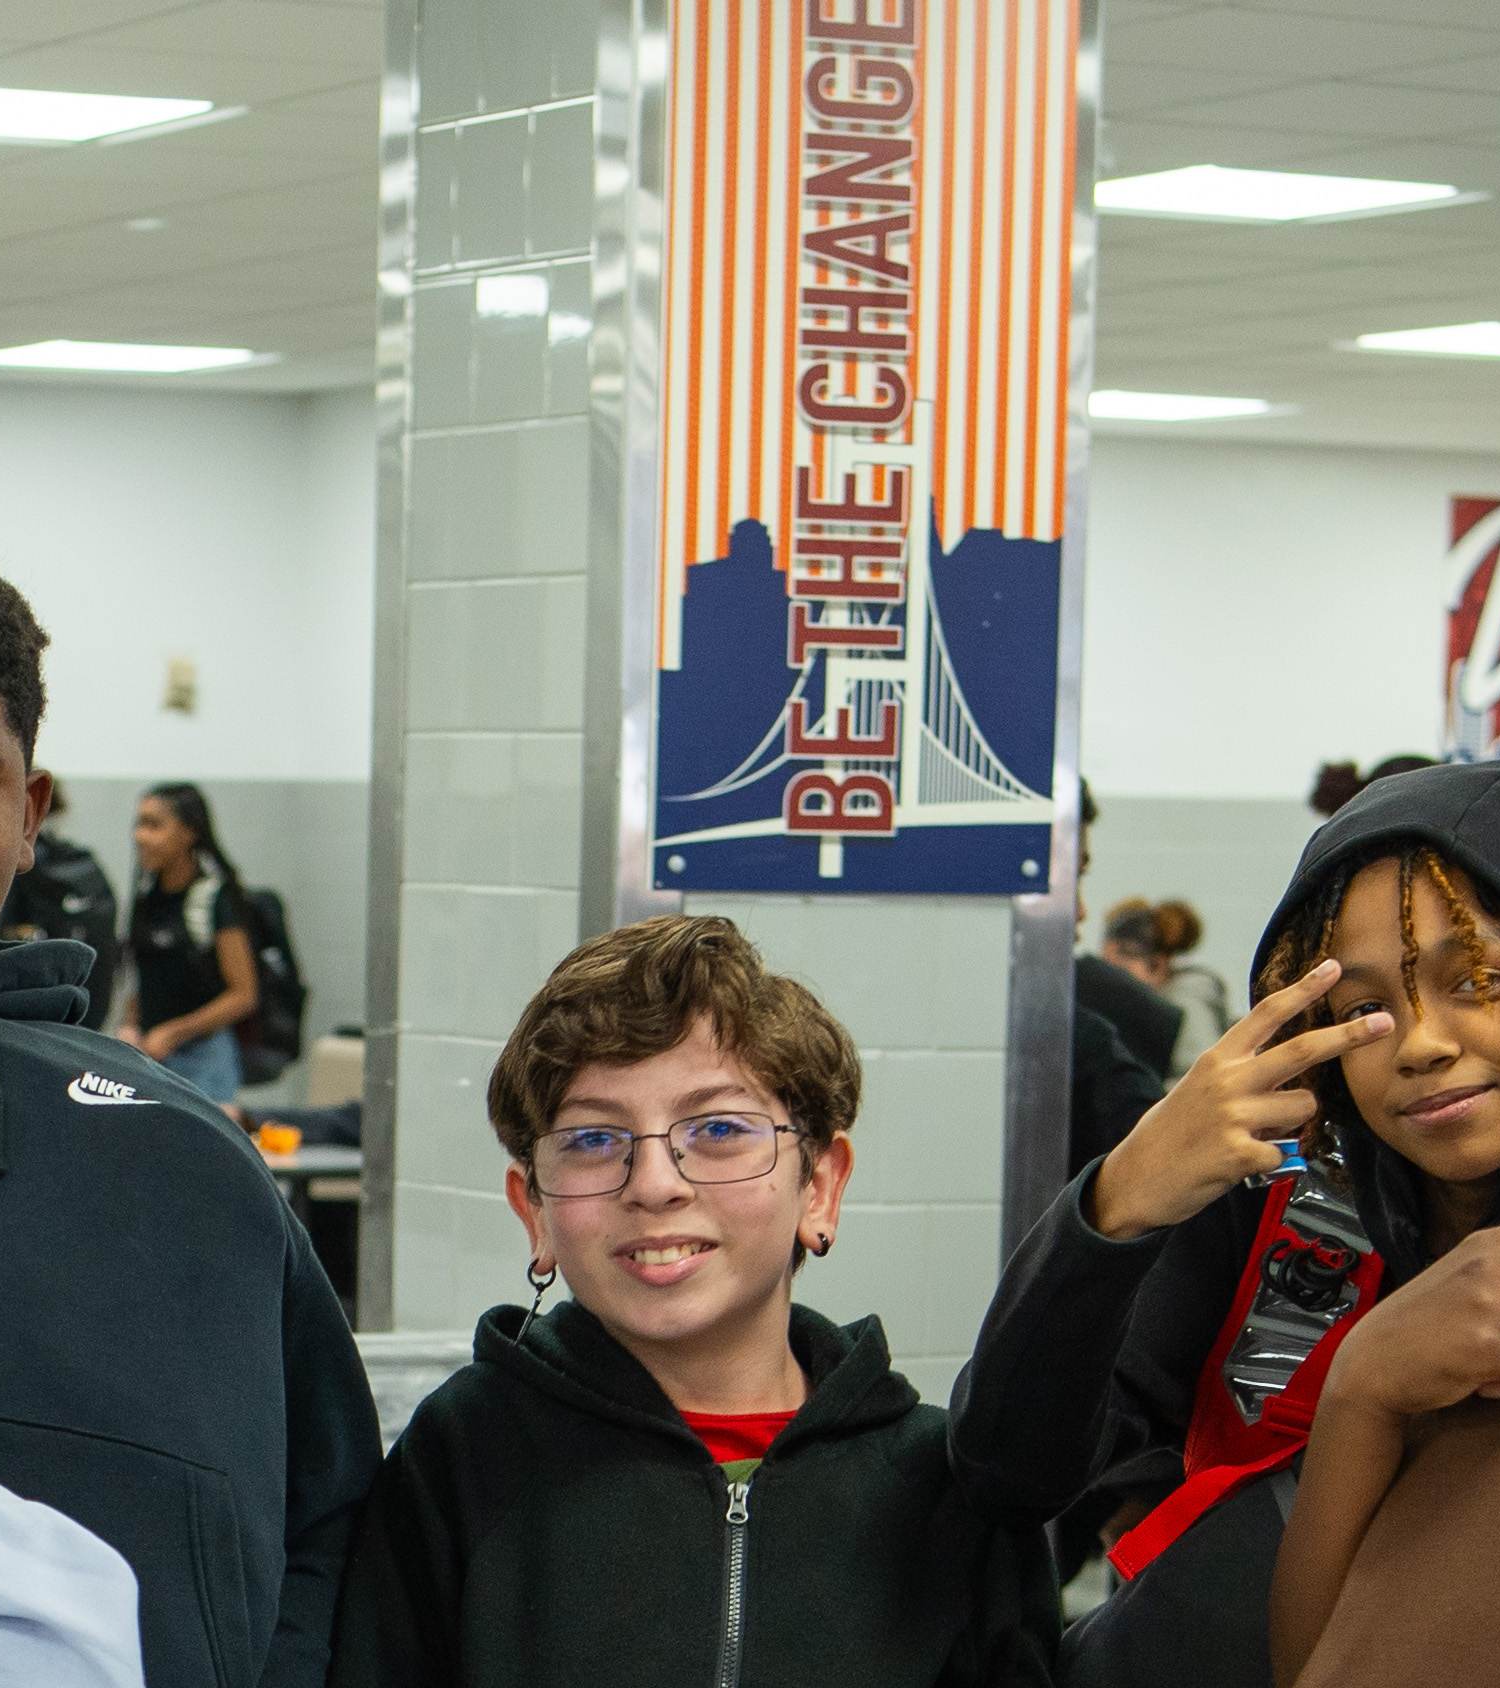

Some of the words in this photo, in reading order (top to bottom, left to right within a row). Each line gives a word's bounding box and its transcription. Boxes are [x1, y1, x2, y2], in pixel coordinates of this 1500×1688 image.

[796, 0, 916, 428] CHANGE
[787, 466, 910, 668] THE
[783, 698, 898, 837] BE
[80, 1071, 137, 1101] NIKE
